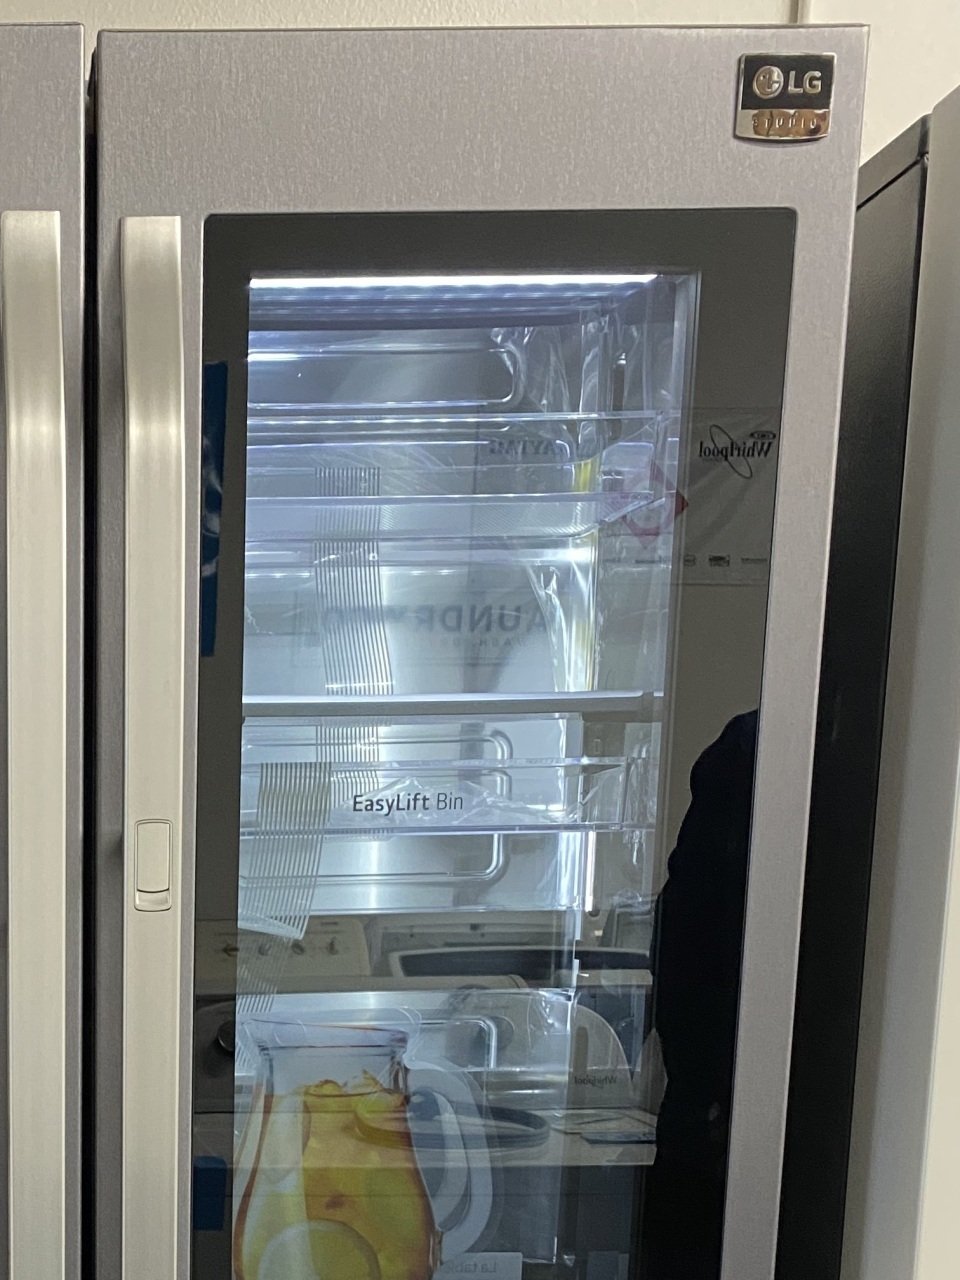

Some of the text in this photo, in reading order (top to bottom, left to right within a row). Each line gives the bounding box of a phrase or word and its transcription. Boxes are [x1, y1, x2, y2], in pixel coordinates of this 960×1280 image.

[787, 70, 822, 94] LG
[352, 791, 463, 817] EasyLift Bin
